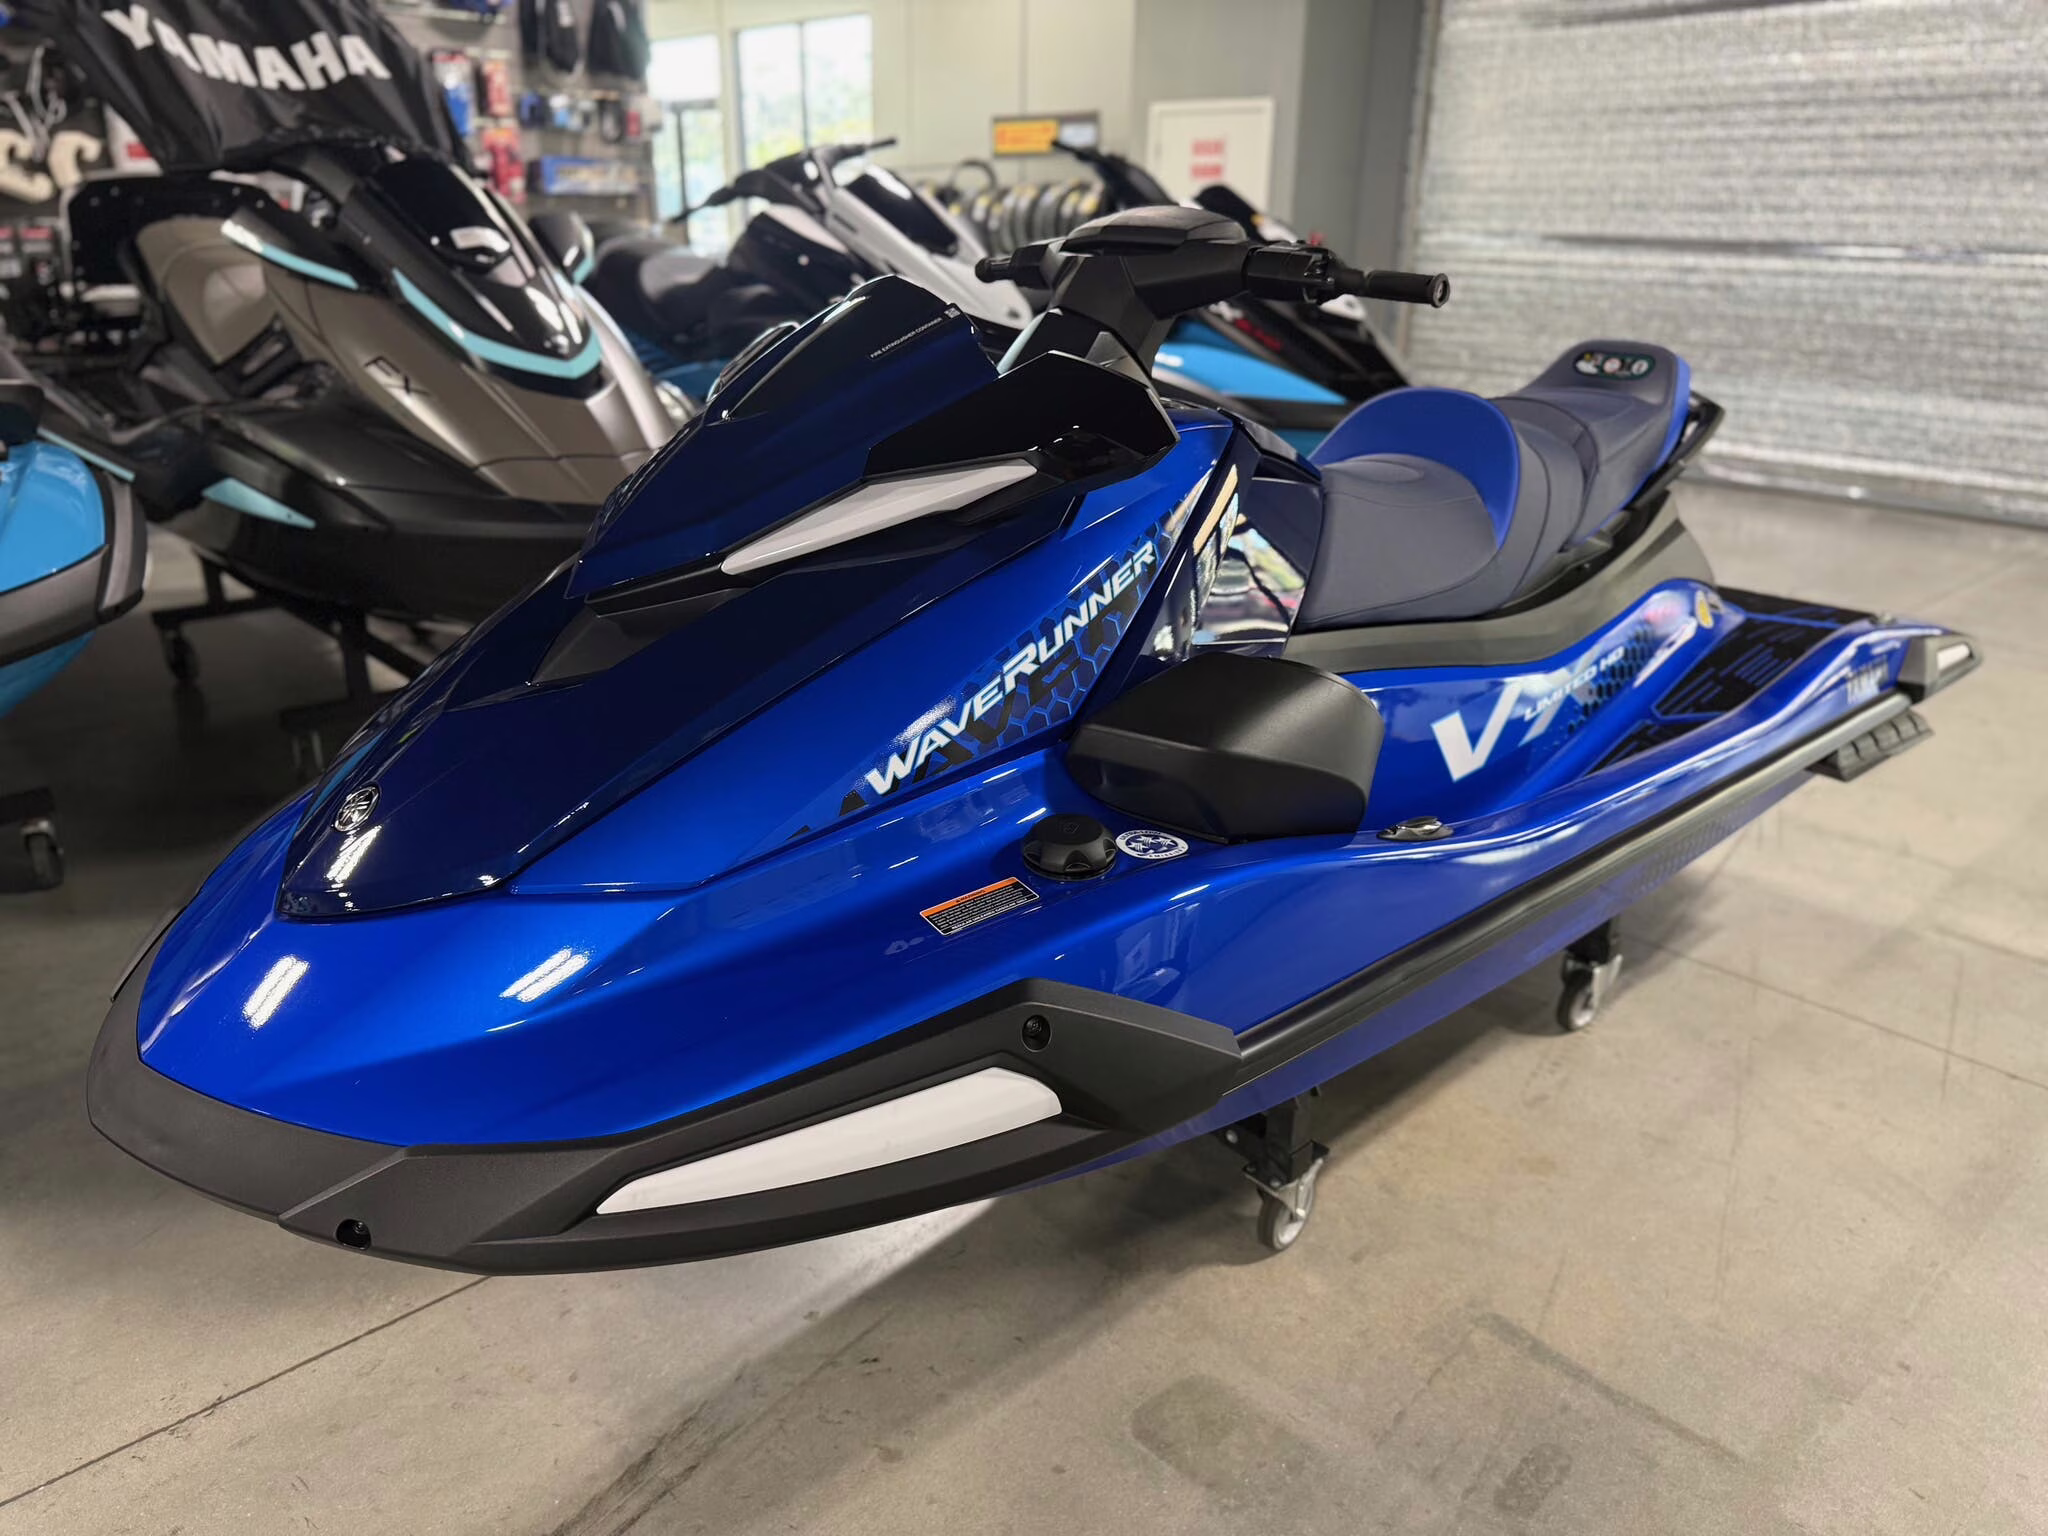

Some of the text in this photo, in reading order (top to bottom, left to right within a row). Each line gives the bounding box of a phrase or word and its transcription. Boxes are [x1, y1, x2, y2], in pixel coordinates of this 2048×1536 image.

[101, 4, 392, 91] YAMAHA
[865, 540, 1157, 796] WAVERUNNER
[1523, 666, 1599, 722] LIMITED
